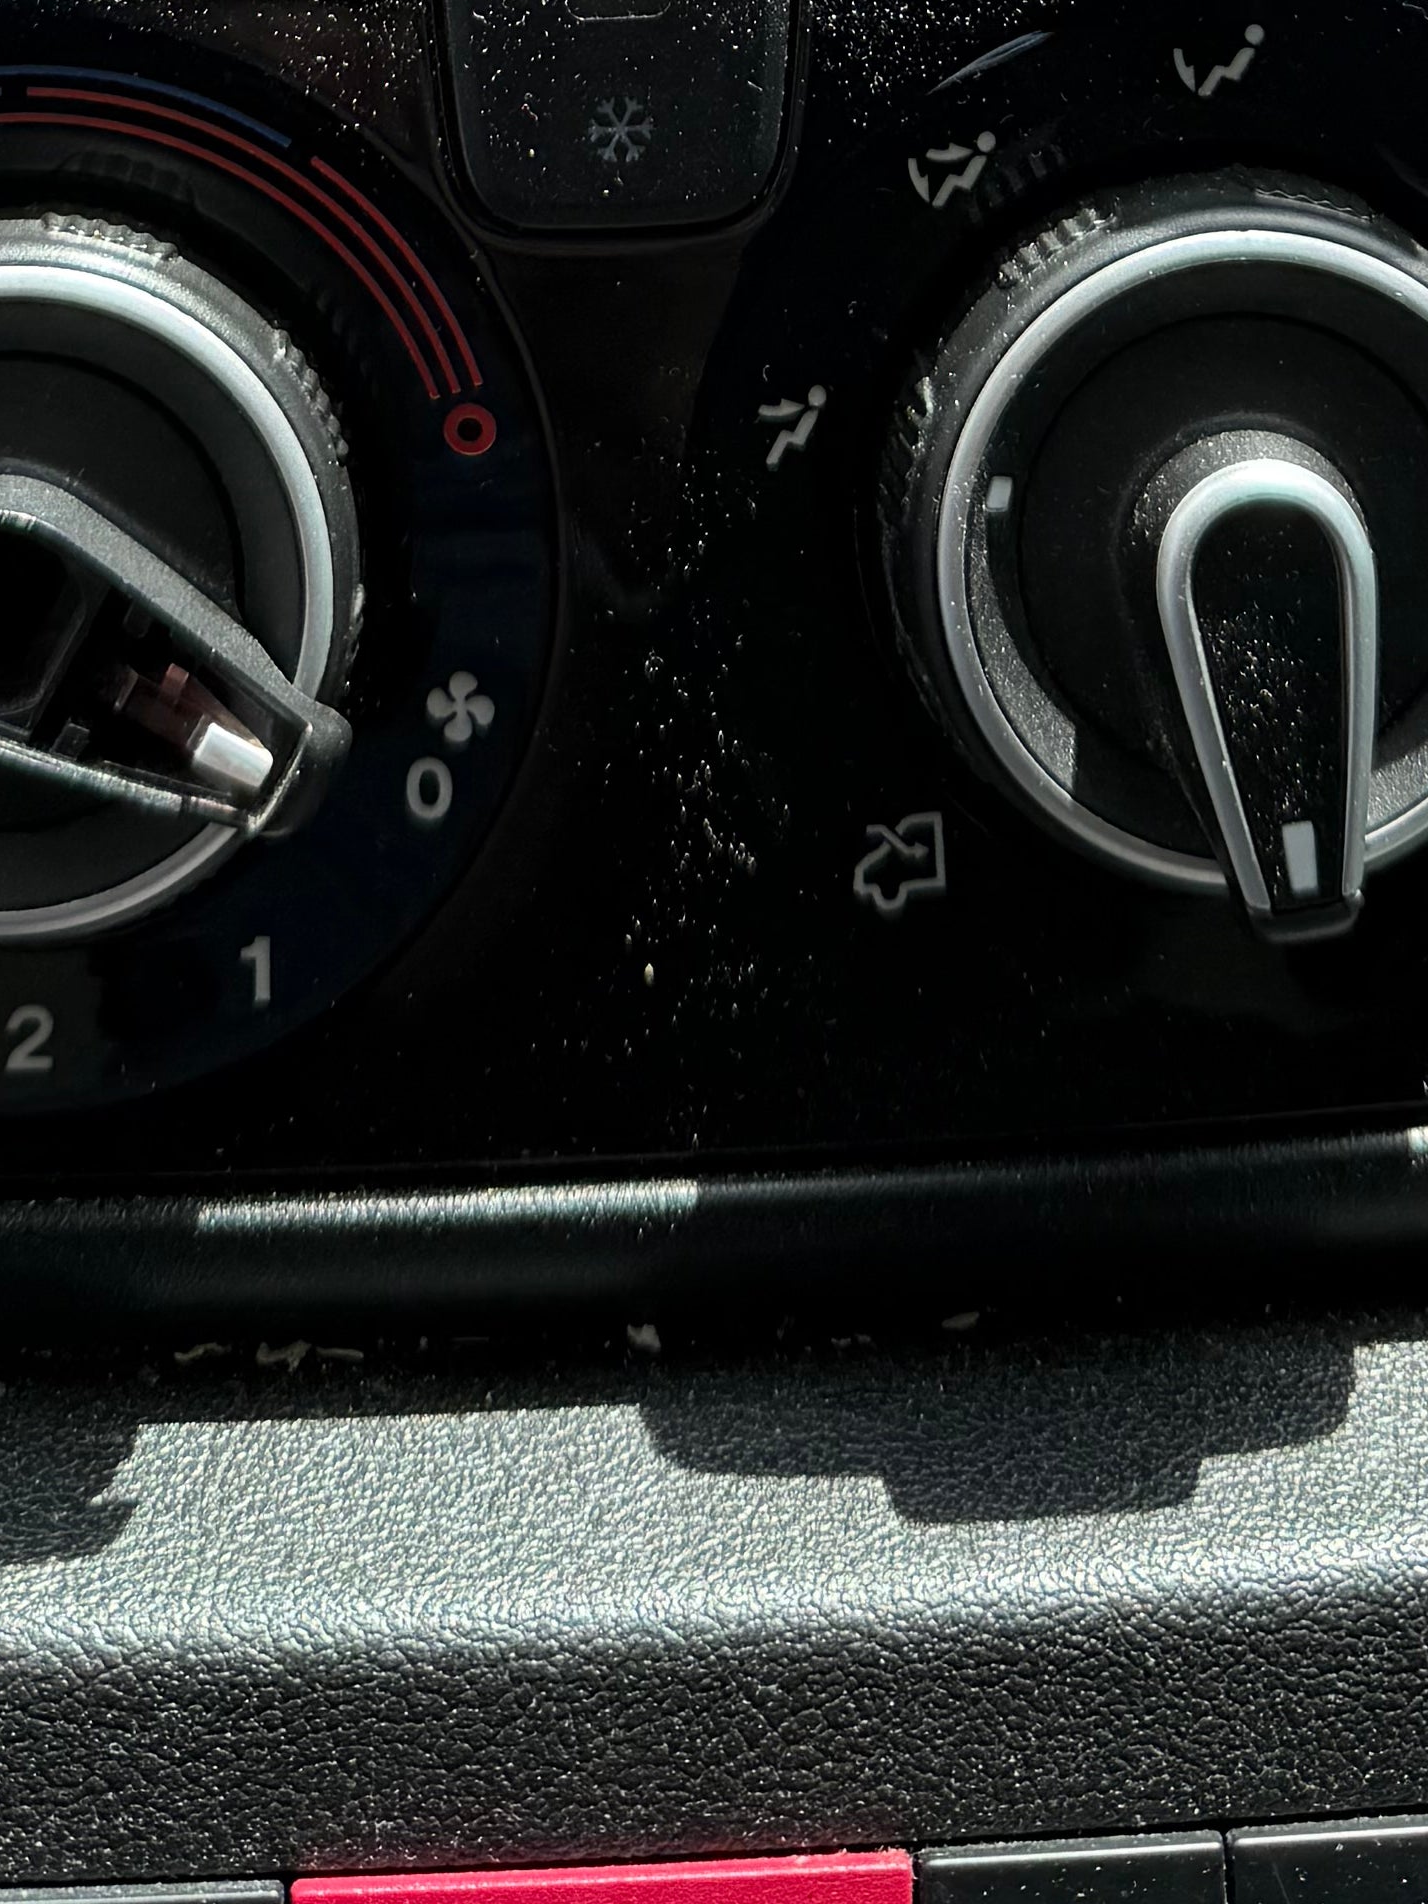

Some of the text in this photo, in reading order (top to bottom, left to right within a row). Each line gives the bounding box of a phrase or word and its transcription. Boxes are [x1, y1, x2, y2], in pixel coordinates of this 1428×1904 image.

[405, 755, 454, 823] 0
[238, 935, 274, 1006] 1
[3, 1003, 56, 1072] 2
